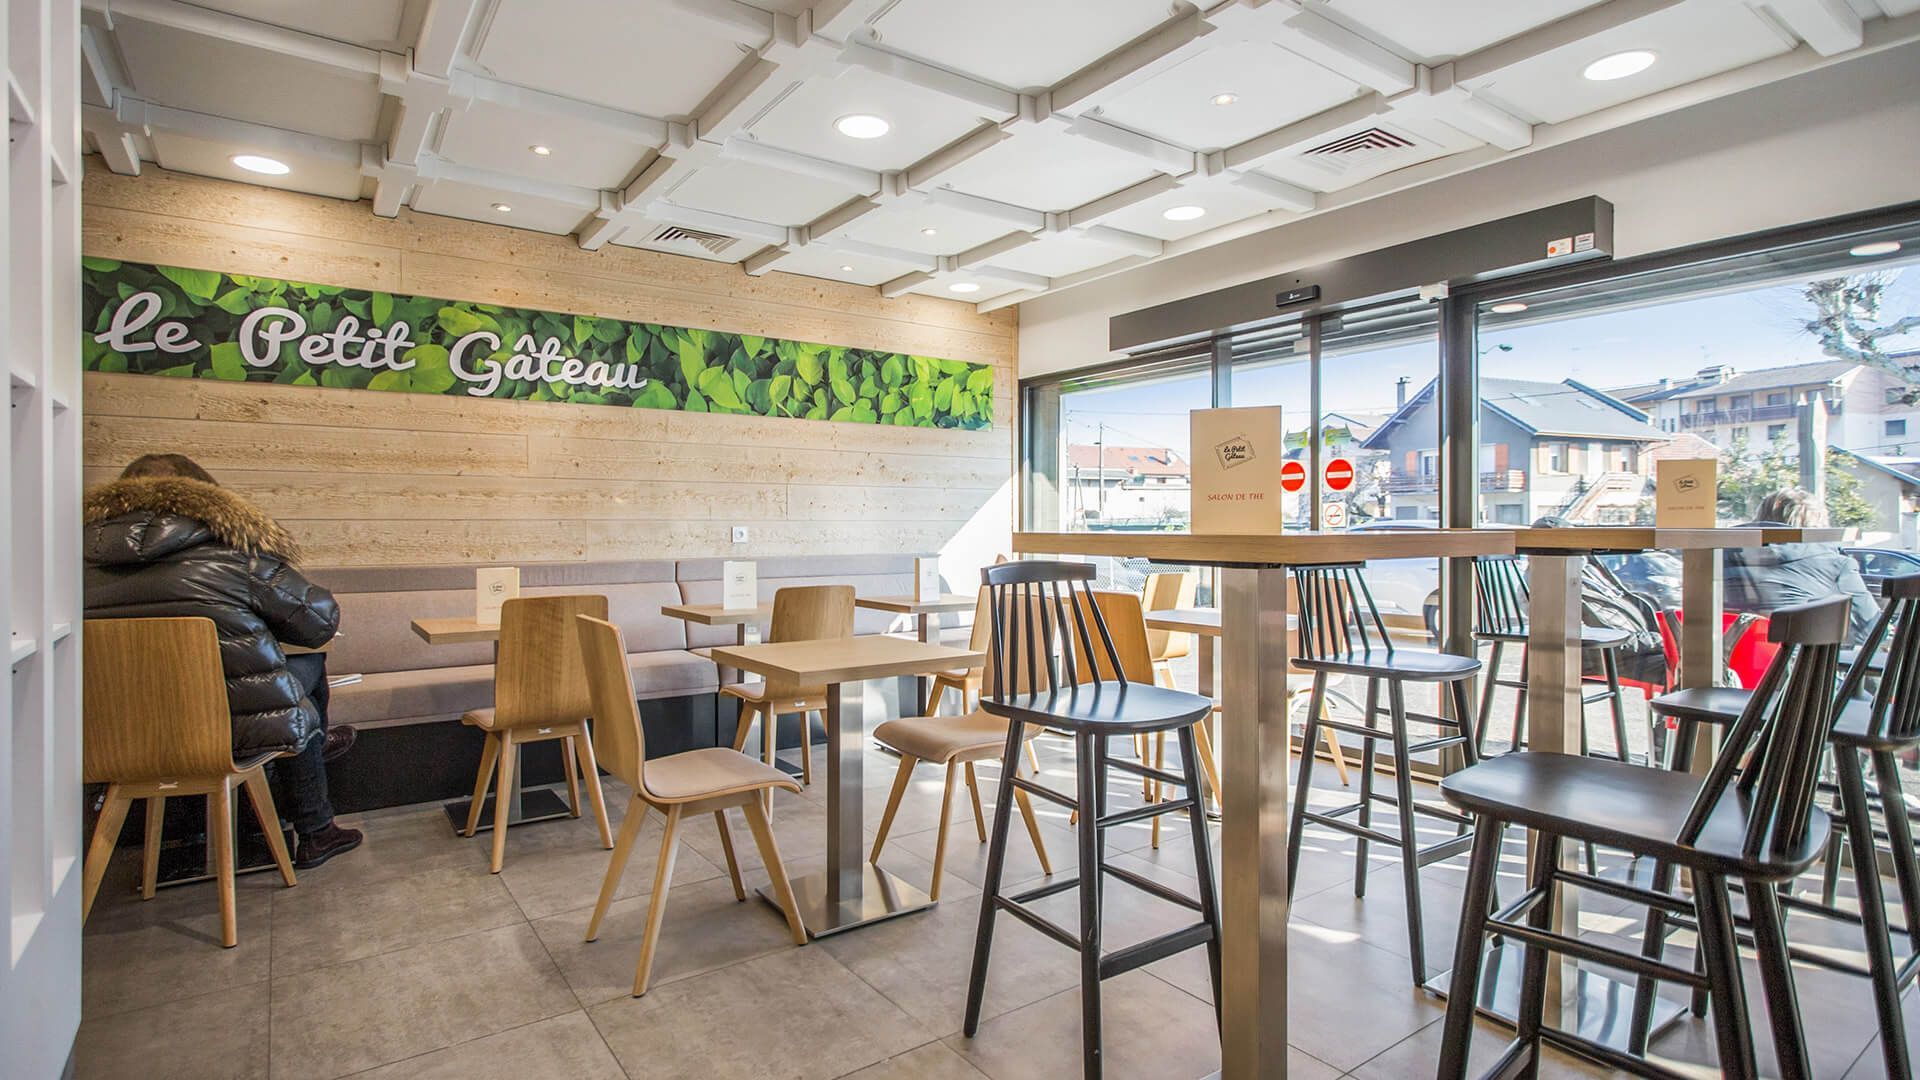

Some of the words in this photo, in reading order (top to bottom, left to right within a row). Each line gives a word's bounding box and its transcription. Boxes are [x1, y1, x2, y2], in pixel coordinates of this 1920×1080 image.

[95, 291, 201, 353] Le
[239, 307, 416, 371] Petit
[449, 331, 648, 397] Gâteau
[1207, 493, 1234, 502] SALON
[1235, 492, 1246, 501] DE
